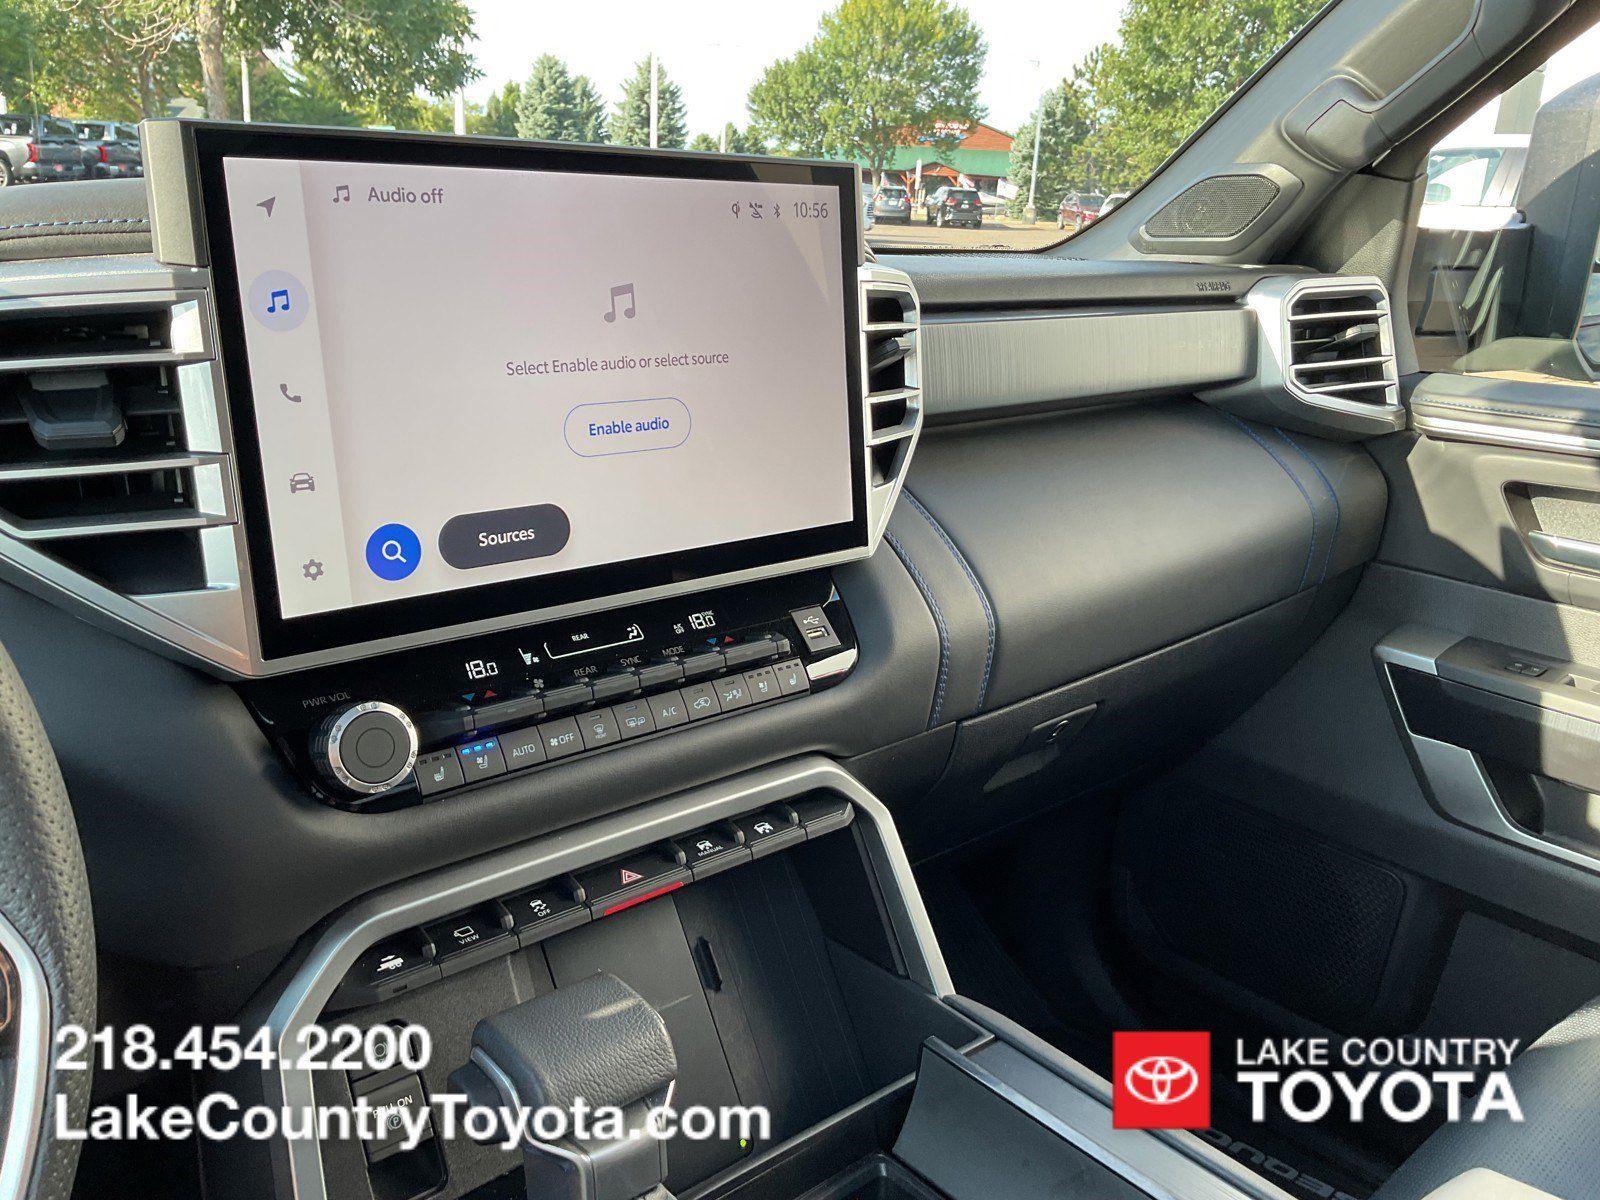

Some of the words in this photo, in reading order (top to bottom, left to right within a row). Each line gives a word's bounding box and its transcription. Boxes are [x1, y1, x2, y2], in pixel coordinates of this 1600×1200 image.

[368, 186, 415, 205] Audio
[420, 186, 444, 204] off
[793, 202, 829, 219] 10:56
[506, 359, 549, 376] Select
[552, 357, 598, 374] Enable
[601, 355, 636, 371] audio
[639, 357, 651, 369] or
[654, 353, 689, 368] select
[691, 351, 729, 366] source
[588, 418, 632, 437] Enable
[634, 416, 670, 433] audio
[478, 525, 535, 548] Sources
[688, 613, 716, 630] 18.0
[571, 632, 590, 642] REAR
[662, 645, 685, 657] MODE
[620, 655, 642, 667] SYNC
[466, 659, 498, 680] 18.0
[573, 665, 598, 678] REAR
[302, 696, 328, 709] PWR
[328, 691, 351, 703] VOL
[662, 706, 677, 718] A/C
[559, 732, 574, 746] OFF
[512, 742, 536, 758] AUTO
[697, 844, 723, 857] MANUAL
[537, 908, 551, 918] OFF
[458, 933, 479, 945] VIEW
[397, 1095, 413, 1108] ON
